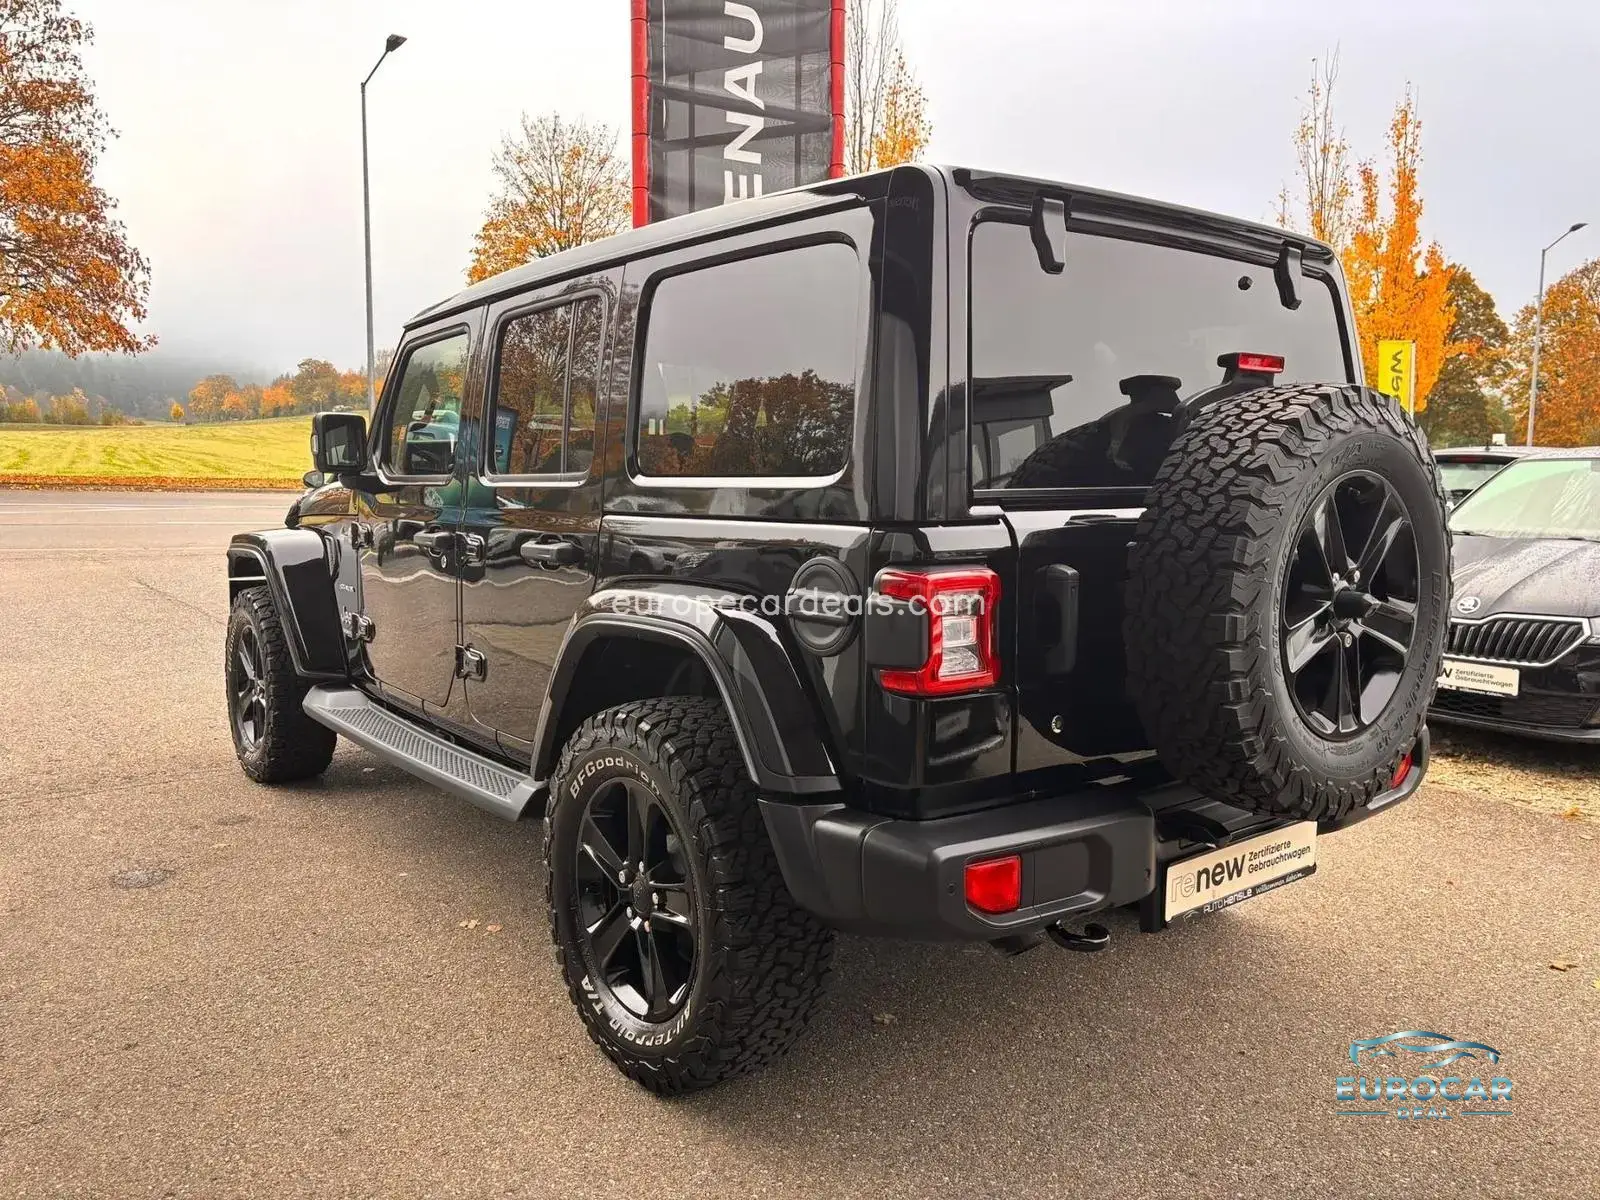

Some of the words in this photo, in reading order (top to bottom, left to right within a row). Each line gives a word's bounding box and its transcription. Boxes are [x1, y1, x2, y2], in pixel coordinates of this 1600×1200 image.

[569, 756, 660, 800] BFGoodrich
[1248, 839, 1291, 862] Zertifizierte
[1248, 845, 1311, 874] Gebrauchtwagen
[1171, 854, 1246, 902] renew
